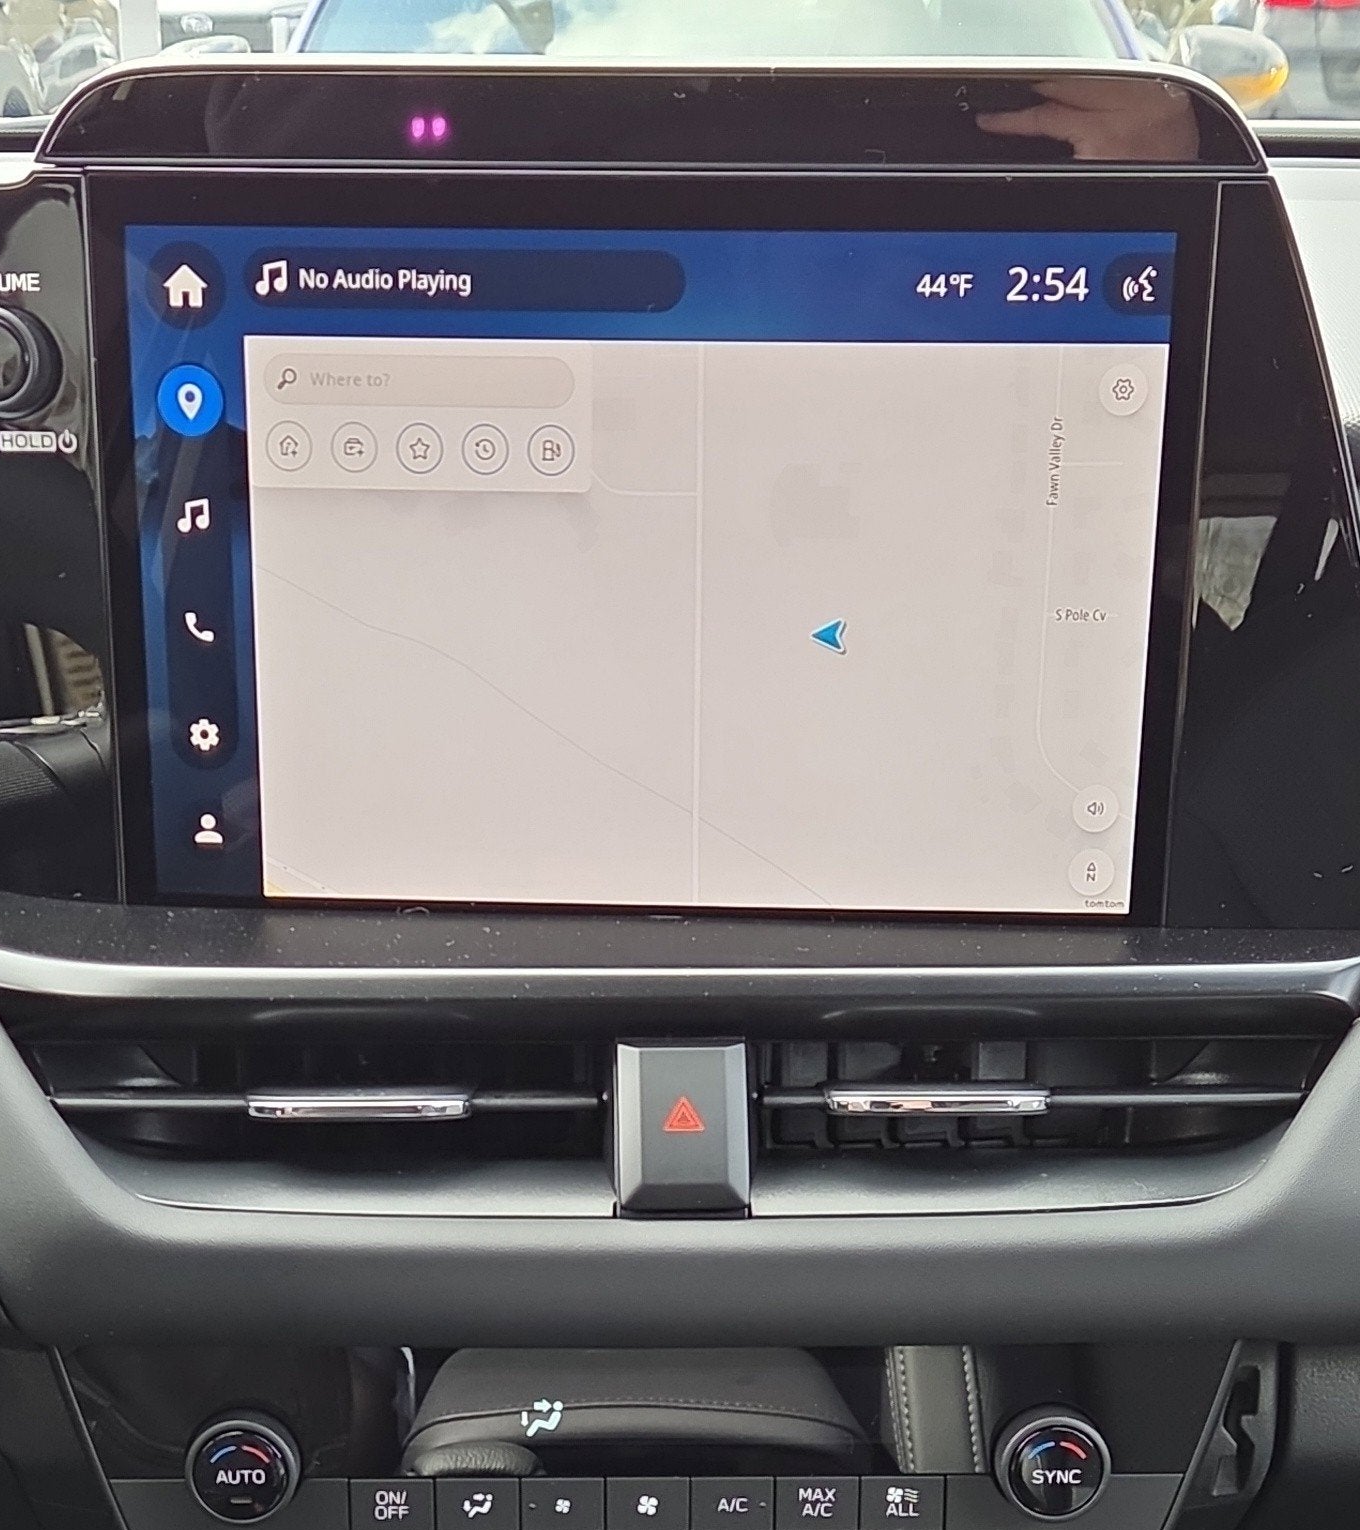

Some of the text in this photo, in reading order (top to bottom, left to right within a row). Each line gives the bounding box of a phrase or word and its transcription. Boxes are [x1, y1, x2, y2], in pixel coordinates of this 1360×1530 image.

[299, 268, 472, 297] No Audio Playing
[916, 274, 974, 298] 44°F
[1006, 266, 1089, 301] 2:54
[310, 372, 391, 388] Where to?
[0, 432, 55, 450] HOLD
[1046, 416, 1066, 506] Fawn Valley Dr
[1055, 608, 1107, 622] S Pole Cv
[216, 1469, 266, 1485] AUTO
[1032, 1469, 1081, 1485] SYNC
[375, 1491, 407, 1506] ON/
[799, 1487, 835, 1502] MAX
[375, 1506, 409, 1520] OFF
[717, 1497, 749, 1513] A/C
[802, 1503, 833, 1518] A/C
[886, 1503, 919, 1518] ALL
